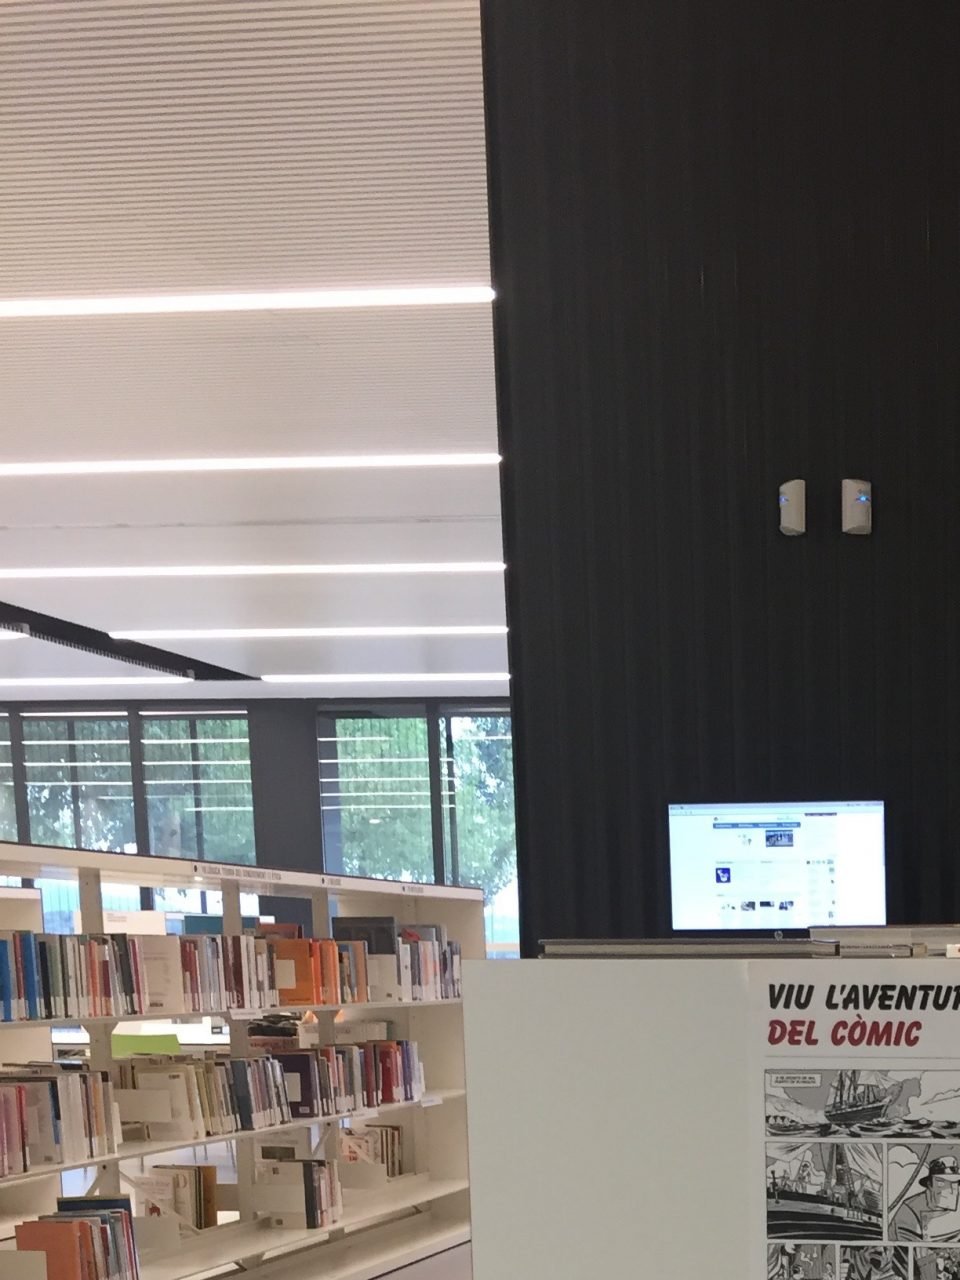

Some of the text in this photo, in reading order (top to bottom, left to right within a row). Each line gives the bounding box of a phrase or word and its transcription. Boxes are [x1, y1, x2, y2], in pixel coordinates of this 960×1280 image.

[768, 983, 815, 1010] VIU
[767, 1013, 923, 1047] DEL CÒMIC
